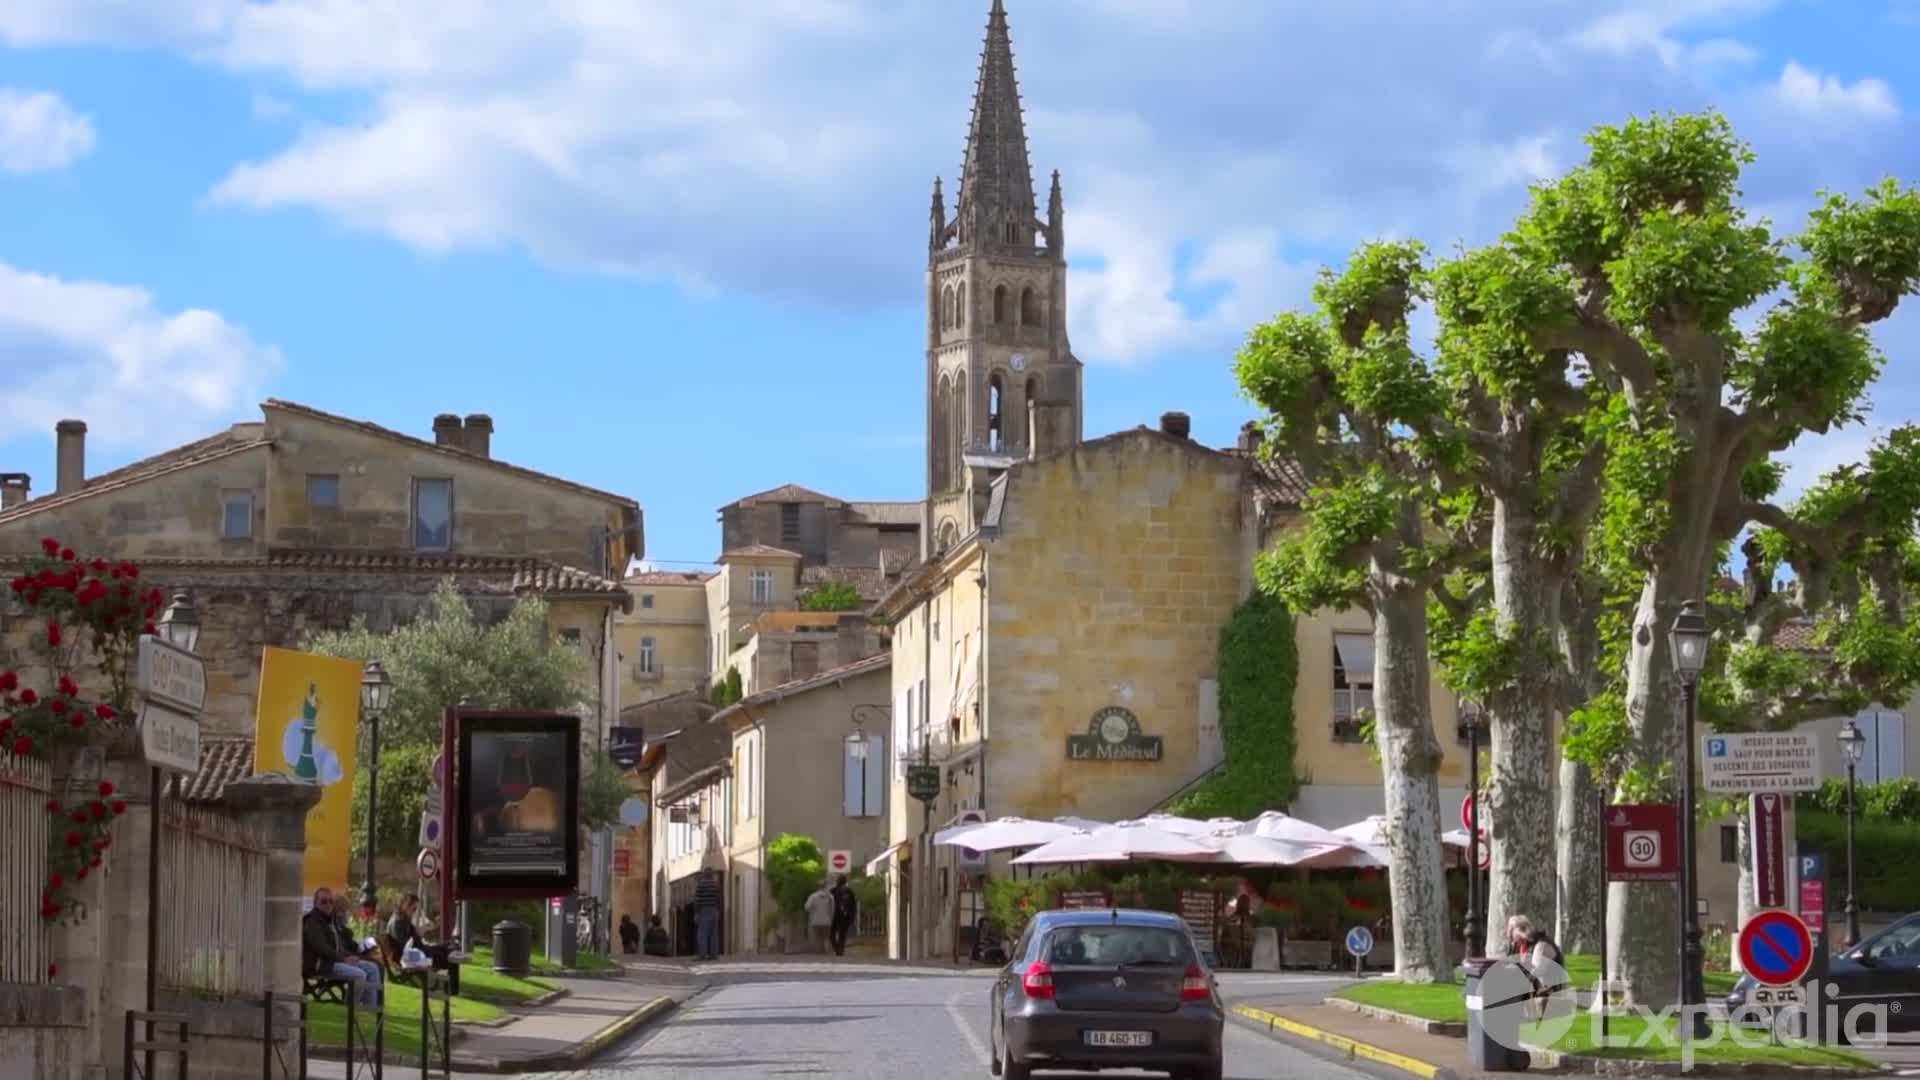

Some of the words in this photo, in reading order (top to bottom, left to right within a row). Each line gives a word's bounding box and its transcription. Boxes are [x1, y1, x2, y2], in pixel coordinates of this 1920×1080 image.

[1072, 743, 1089, 759] Le
[1712, 741, 1723, 756] P
[1711, 778, 1748, 788] PARKING
[1751, 777, 1768, 787] BUS
[1634, 842, 1651, 856] 30
[1803, 858, 1815, 876] P
